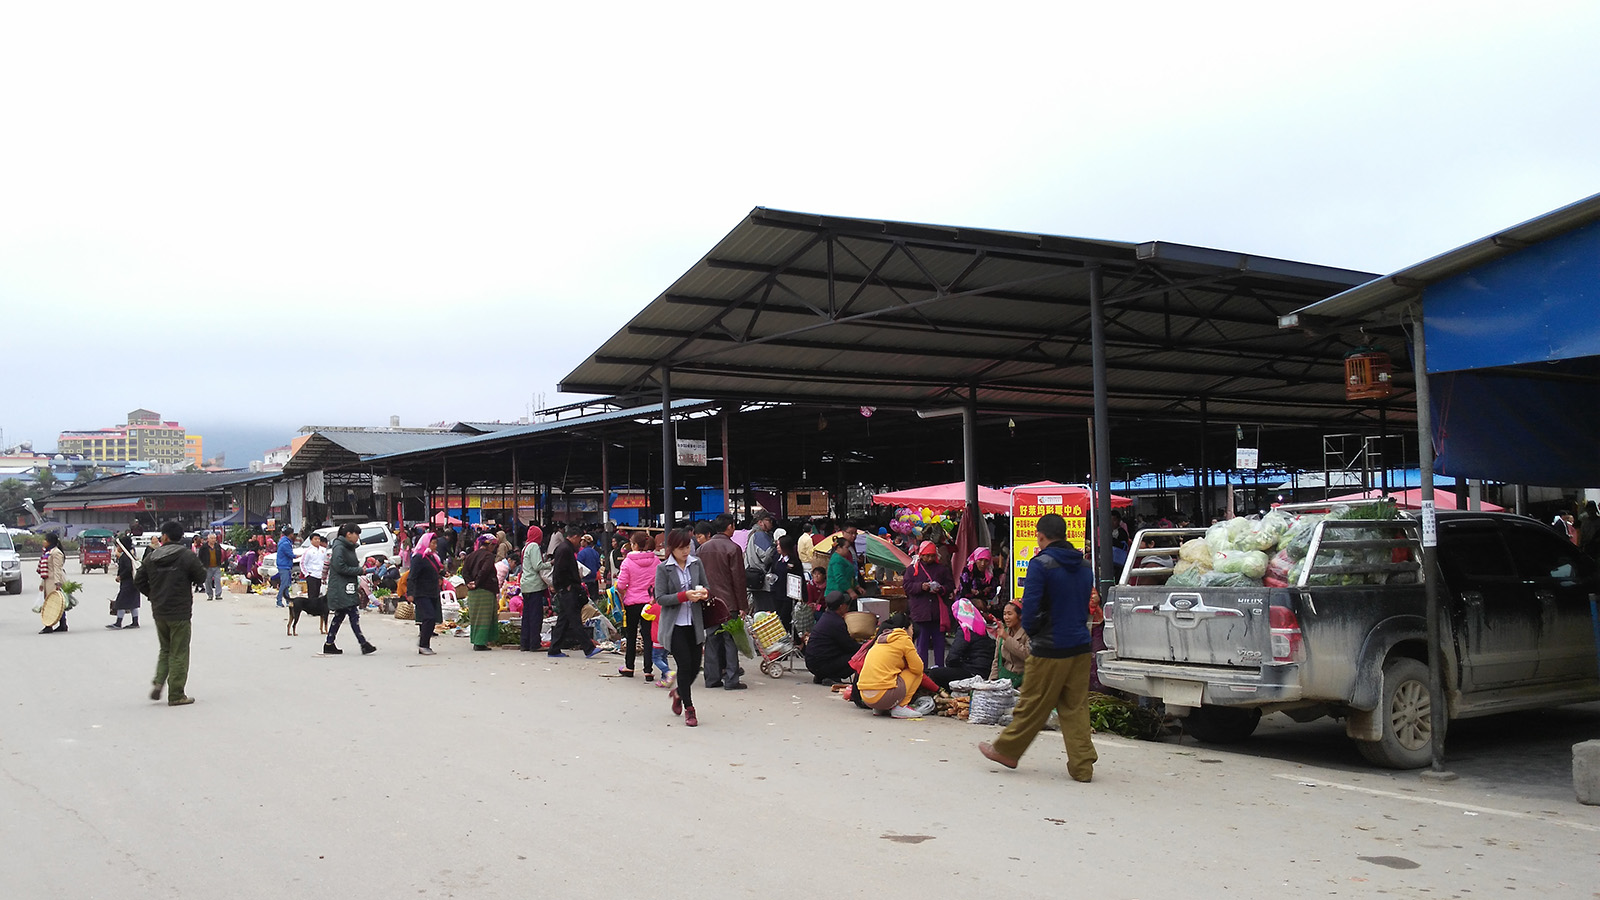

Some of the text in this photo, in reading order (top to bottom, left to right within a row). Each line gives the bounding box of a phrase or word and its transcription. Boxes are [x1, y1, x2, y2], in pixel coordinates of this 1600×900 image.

[1019, 505, 1082, 516] 好莱坞彩票中心
